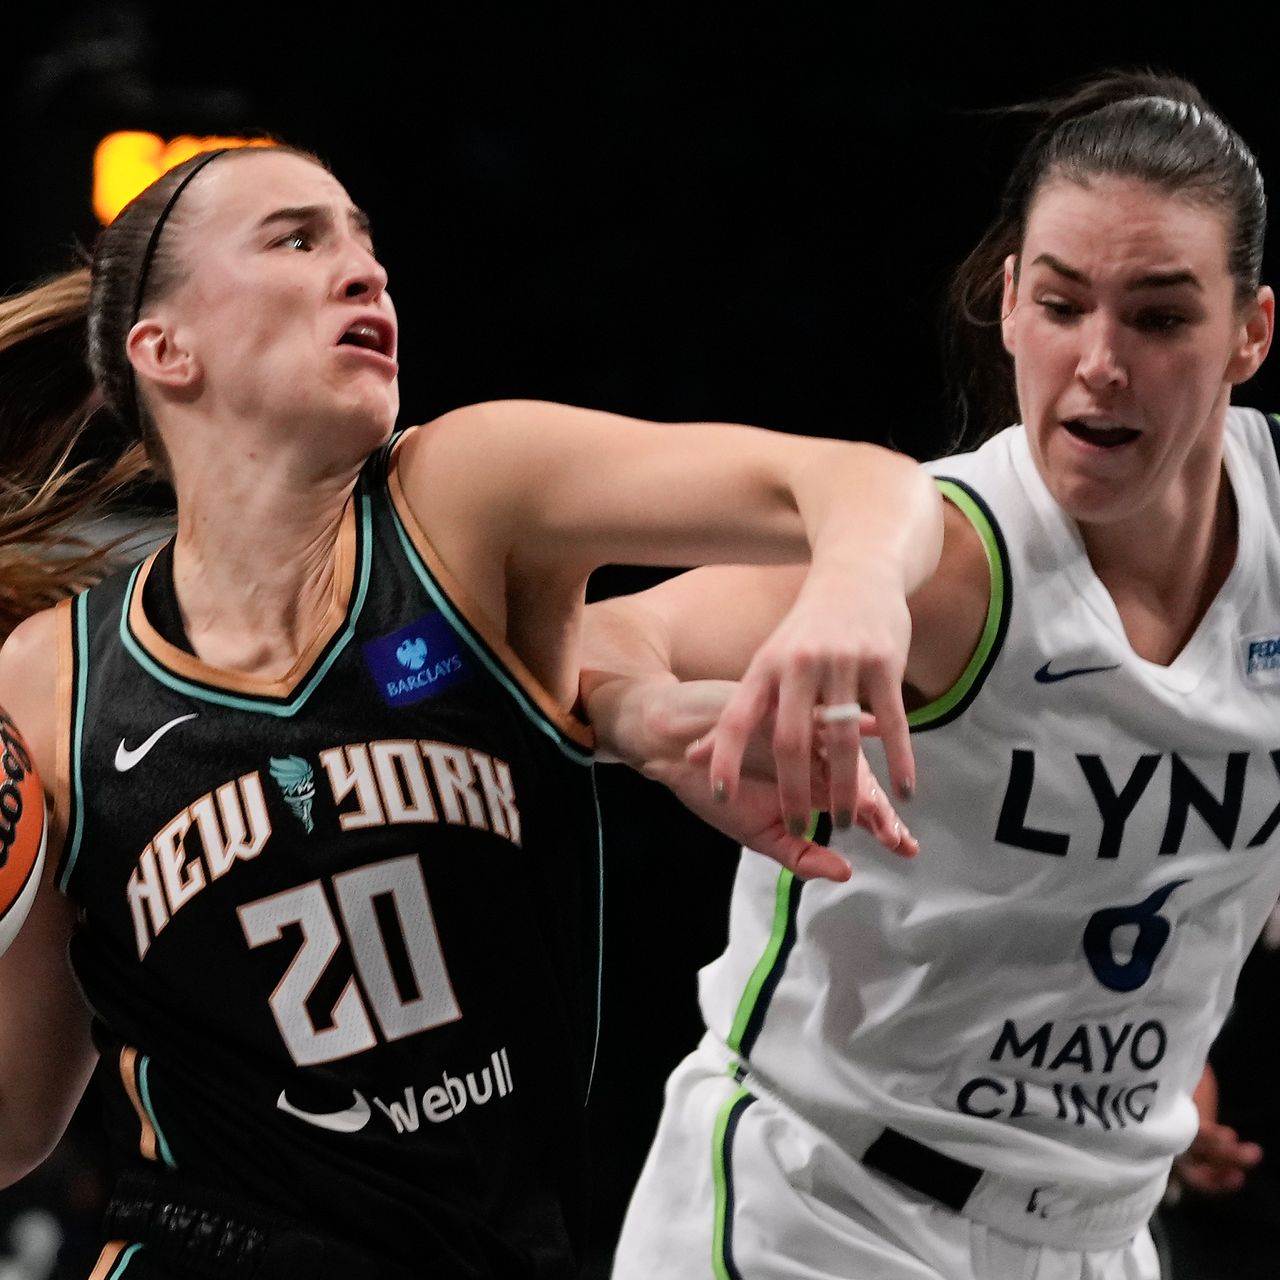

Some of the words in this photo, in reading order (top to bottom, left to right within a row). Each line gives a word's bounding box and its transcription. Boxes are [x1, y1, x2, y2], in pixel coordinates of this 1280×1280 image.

[386, 654, 462, 697] BARCLAYS
[126, 770, 273, 962] NEW
[320, 739, 521, 848] YORK
[235, 853, 462, 1067] 20
[1083, 879, 1192, 993] 6
[372, 1046, 514, 1134] Webull
[989, 1019, 1167, 1073] MAYO
[956, 1076, 1159, 1131] CLINIC
